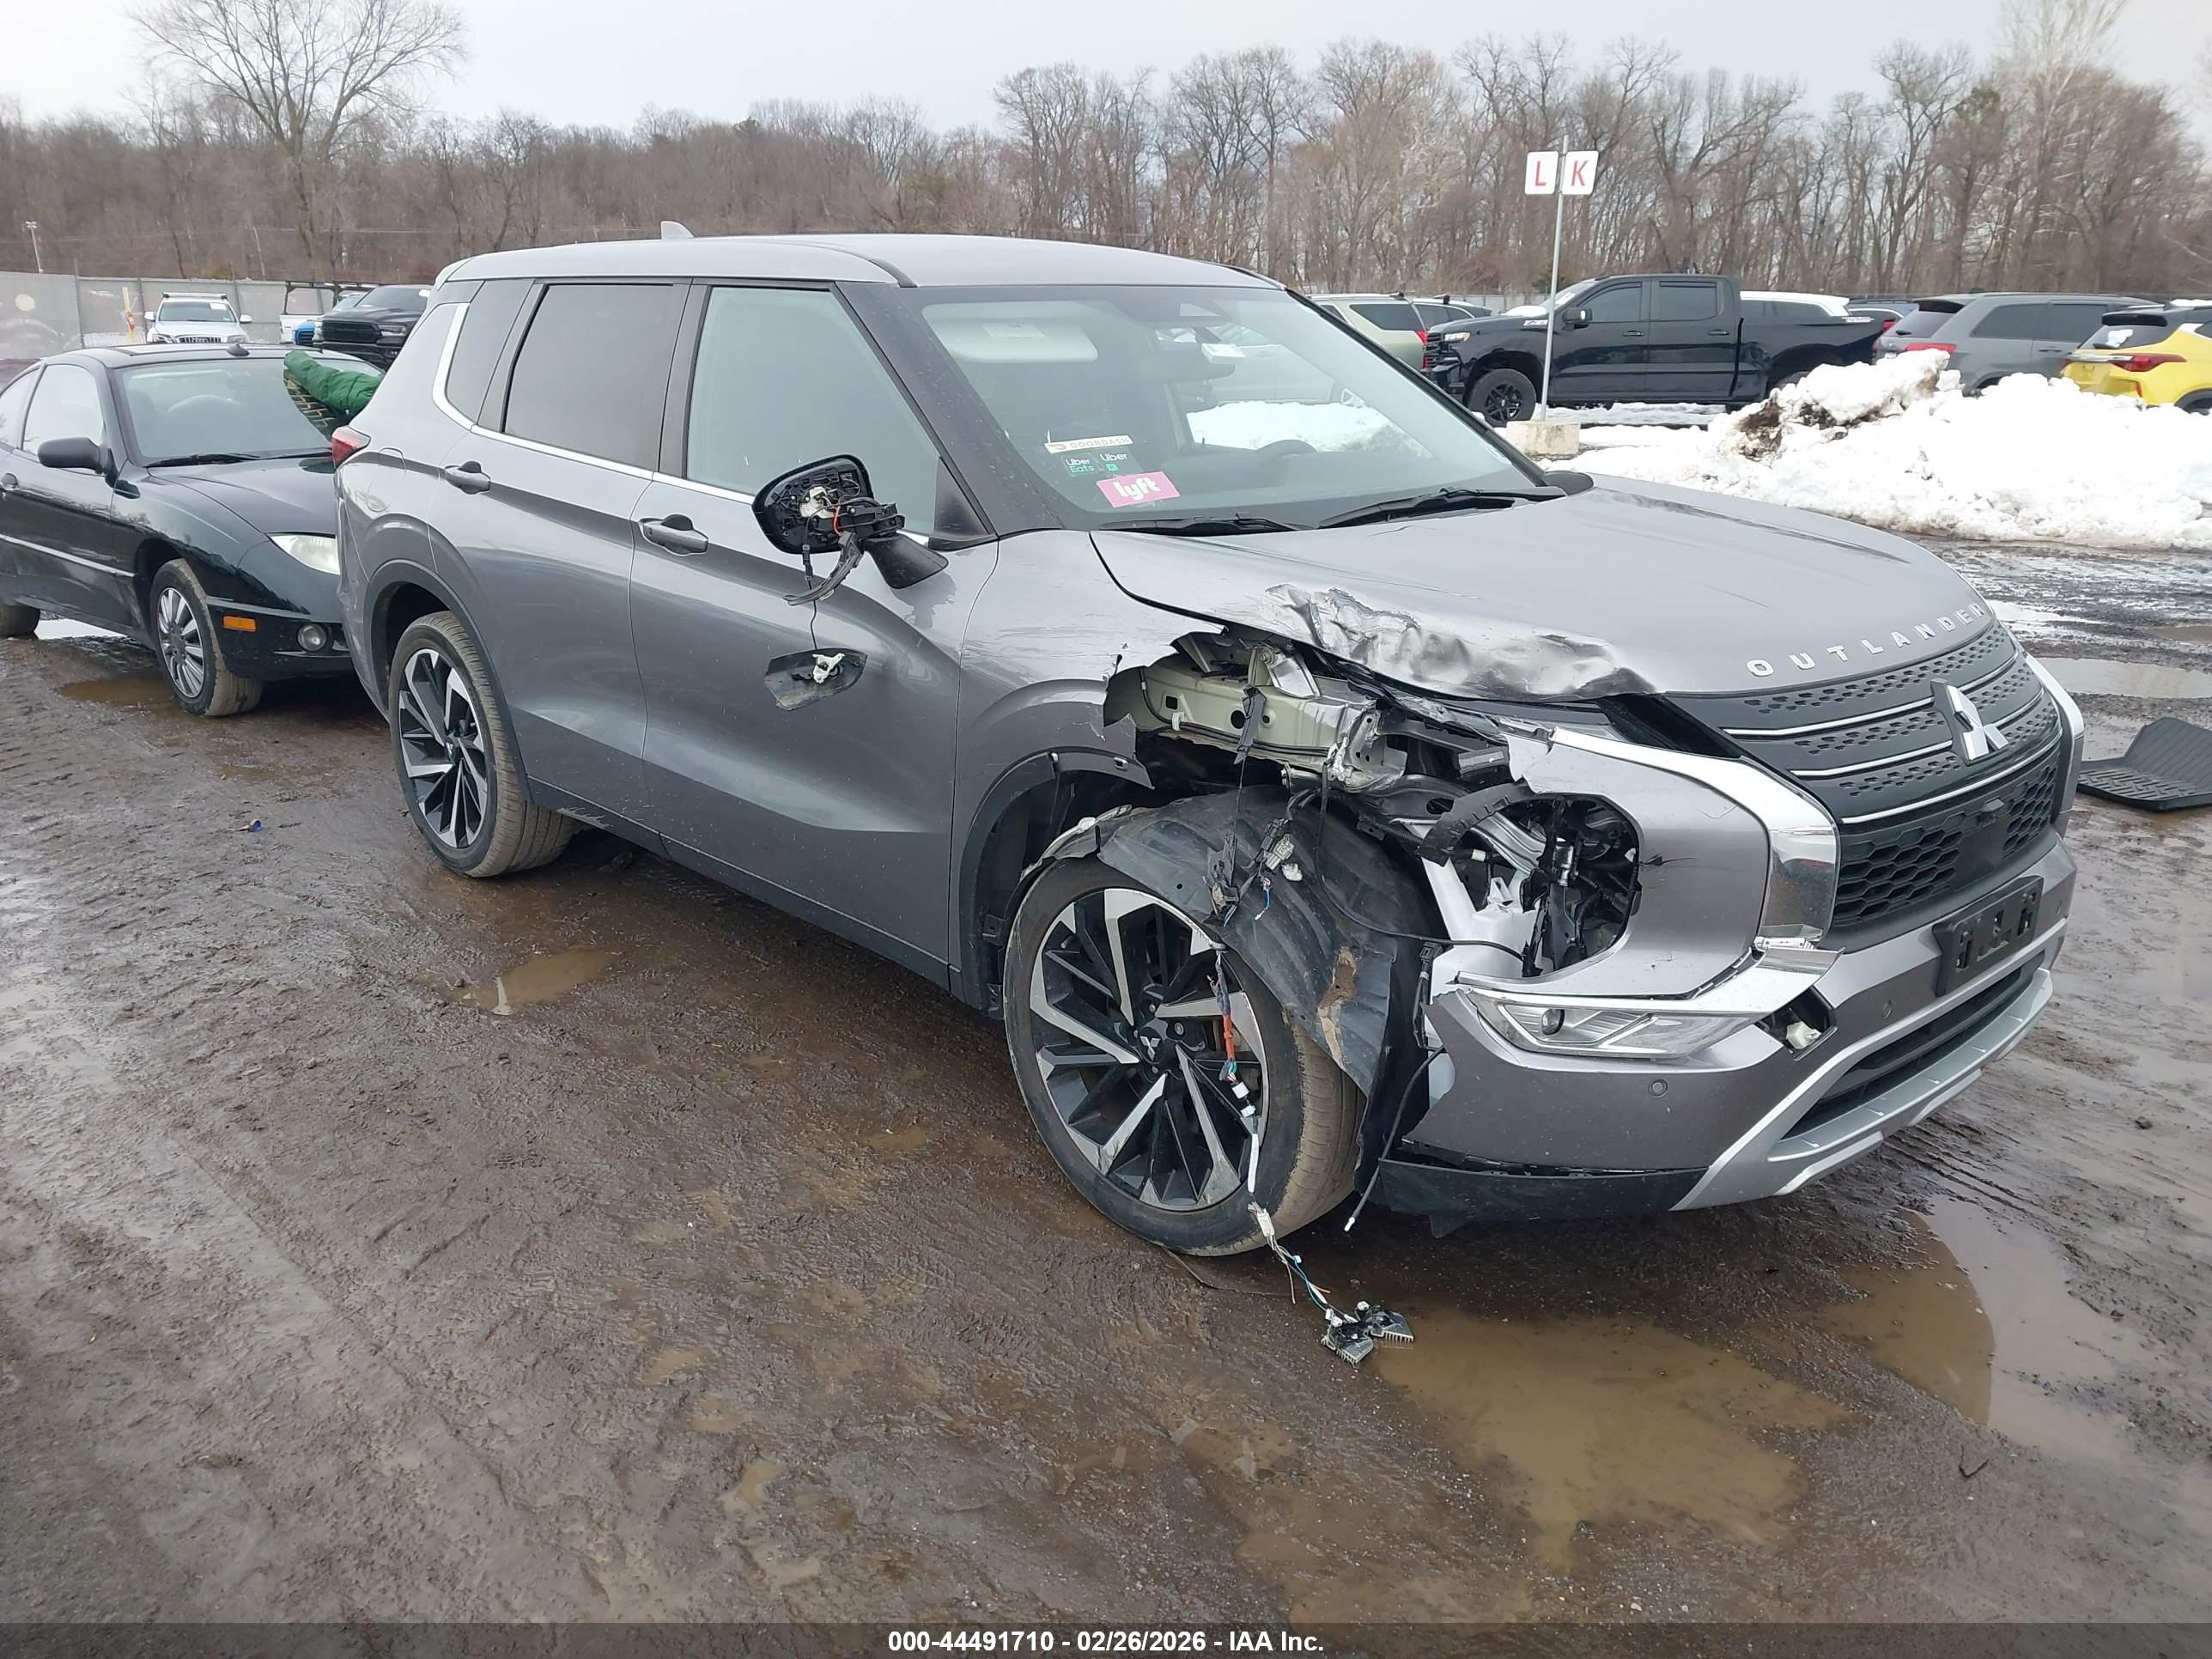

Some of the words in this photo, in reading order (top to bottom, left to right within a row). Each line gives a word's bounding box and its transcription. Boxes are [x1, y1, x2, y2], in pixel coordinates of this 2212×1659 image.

[1534, 160, 1547, 186] L
[1571, 160, 1589, 186] K
[1070, 437, 1130, 448] DOORDASH
[1069, 465, 1095, 473] Eats
[1112, 477, 1162, 501] lyft
[1746, 602, 1986, 678] OUTLANDER
